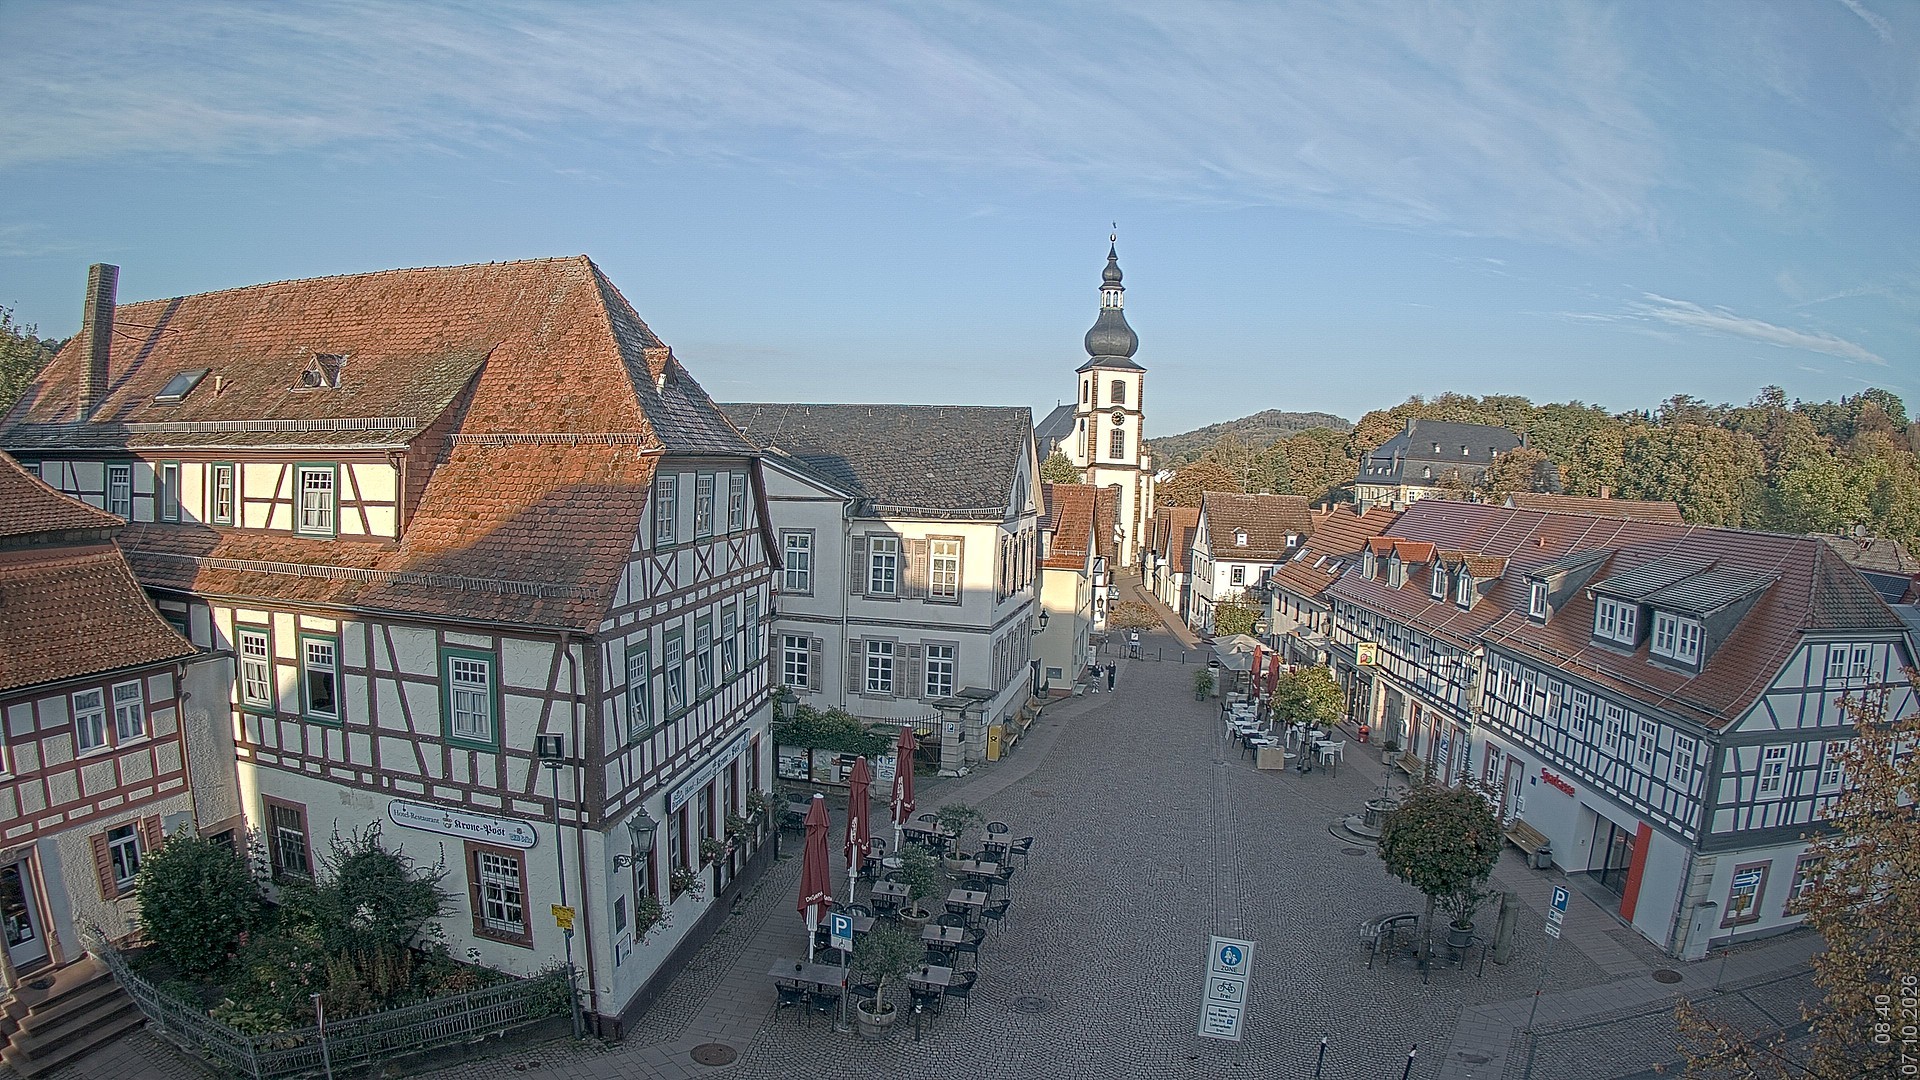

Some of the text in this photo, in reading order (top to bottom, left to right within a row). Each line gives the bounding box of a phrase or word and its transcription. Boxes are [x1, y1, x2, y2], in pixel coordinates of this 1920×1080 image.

[1554, 890, 1565, 906] P
[836, 917, 847, 934] P
[1220, 965, 1237, 973] ZONE
